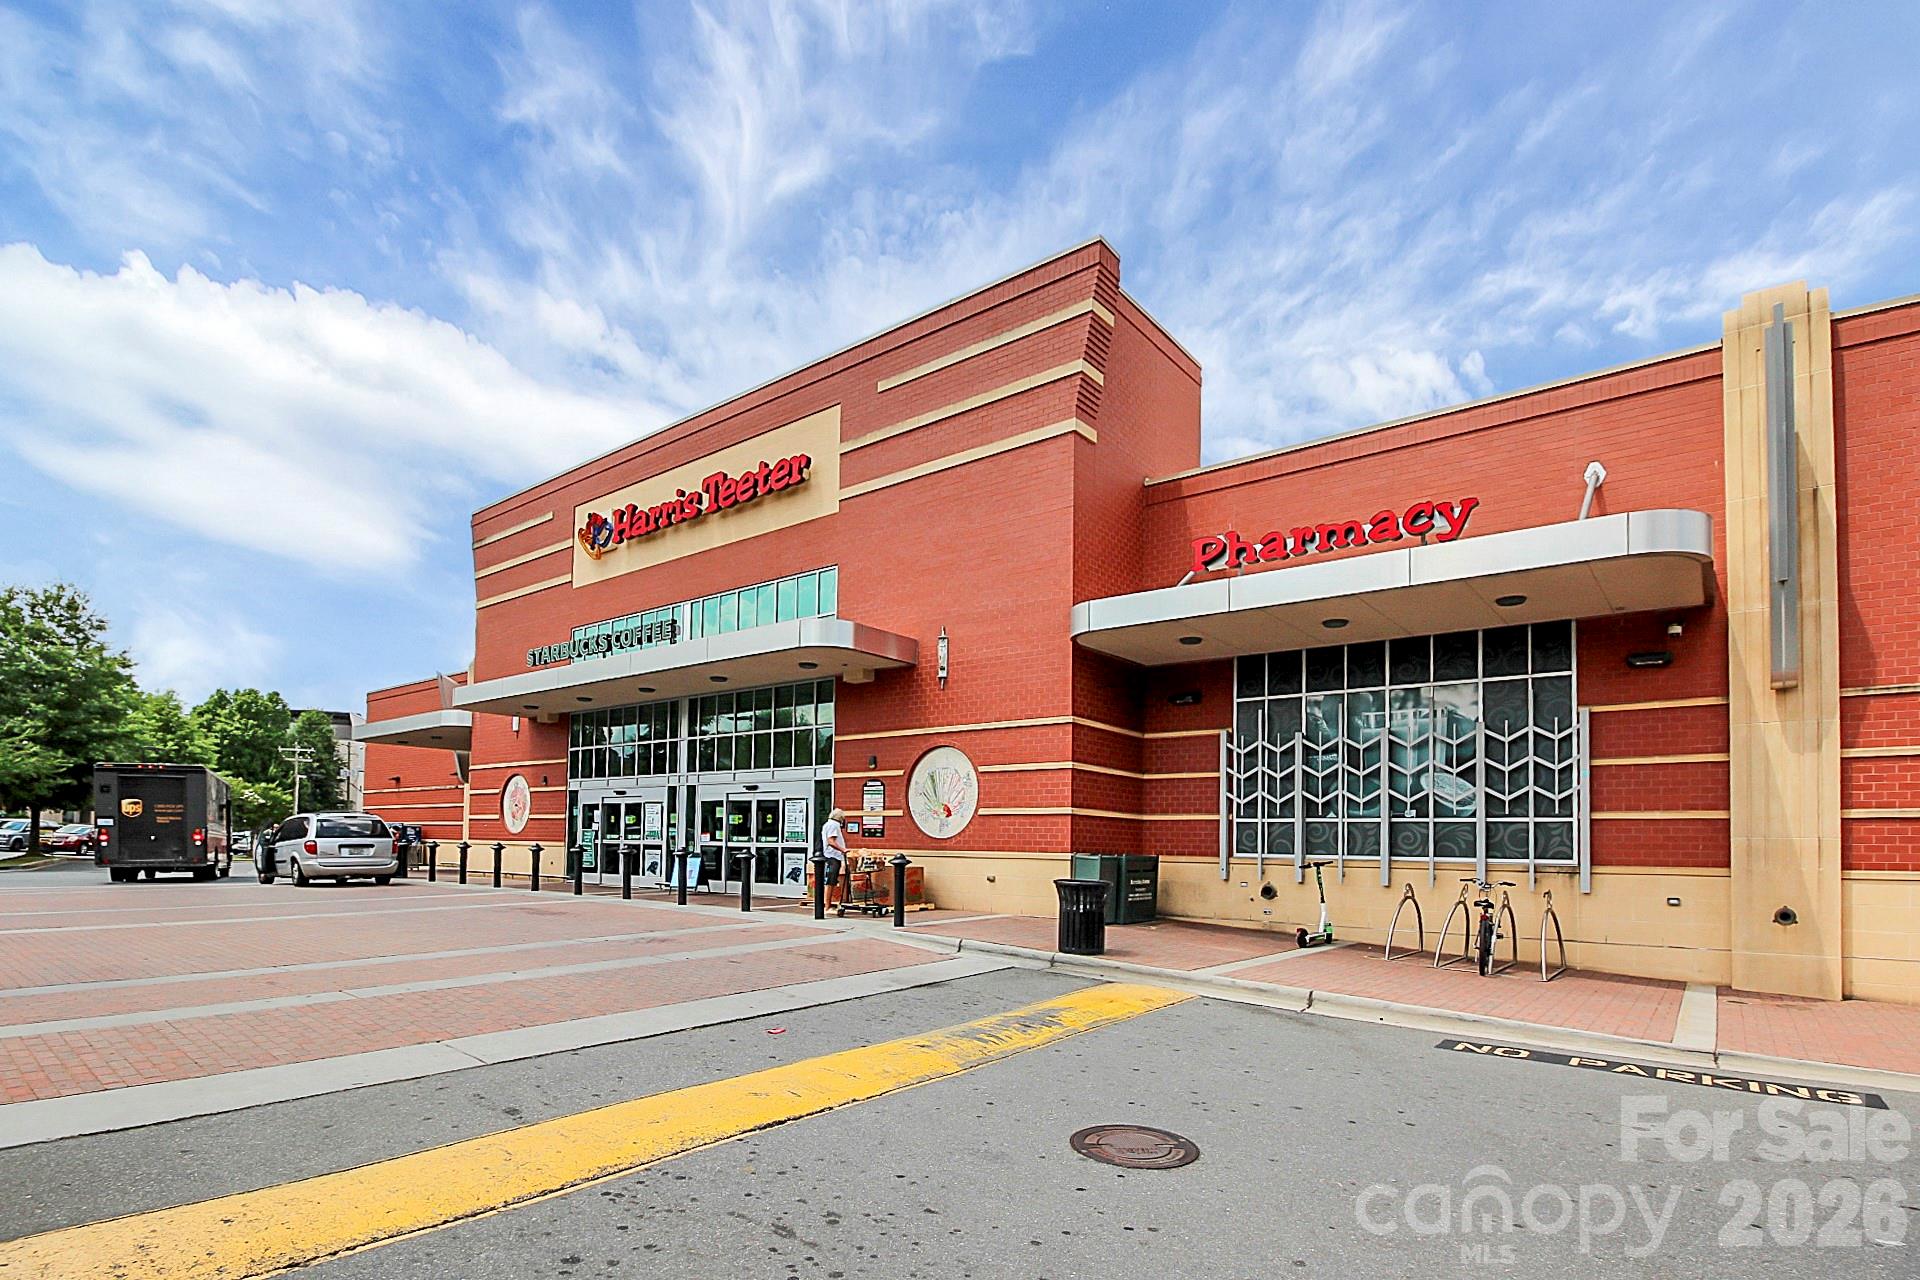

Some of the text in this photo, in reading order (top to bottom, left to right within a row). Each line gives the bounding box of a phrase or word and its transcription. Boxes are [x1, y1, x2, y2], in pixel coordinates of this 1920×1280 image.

[612, 453, 811, 544] Harris Teeter
[1191, 497, 1480, 572] Pharmacy
[526, 620, 675, 667] STARBUCKS COFFEE
[124, 805, 141, 815] ups
[1455, 1042, 1866, 1106] NO PARKING
